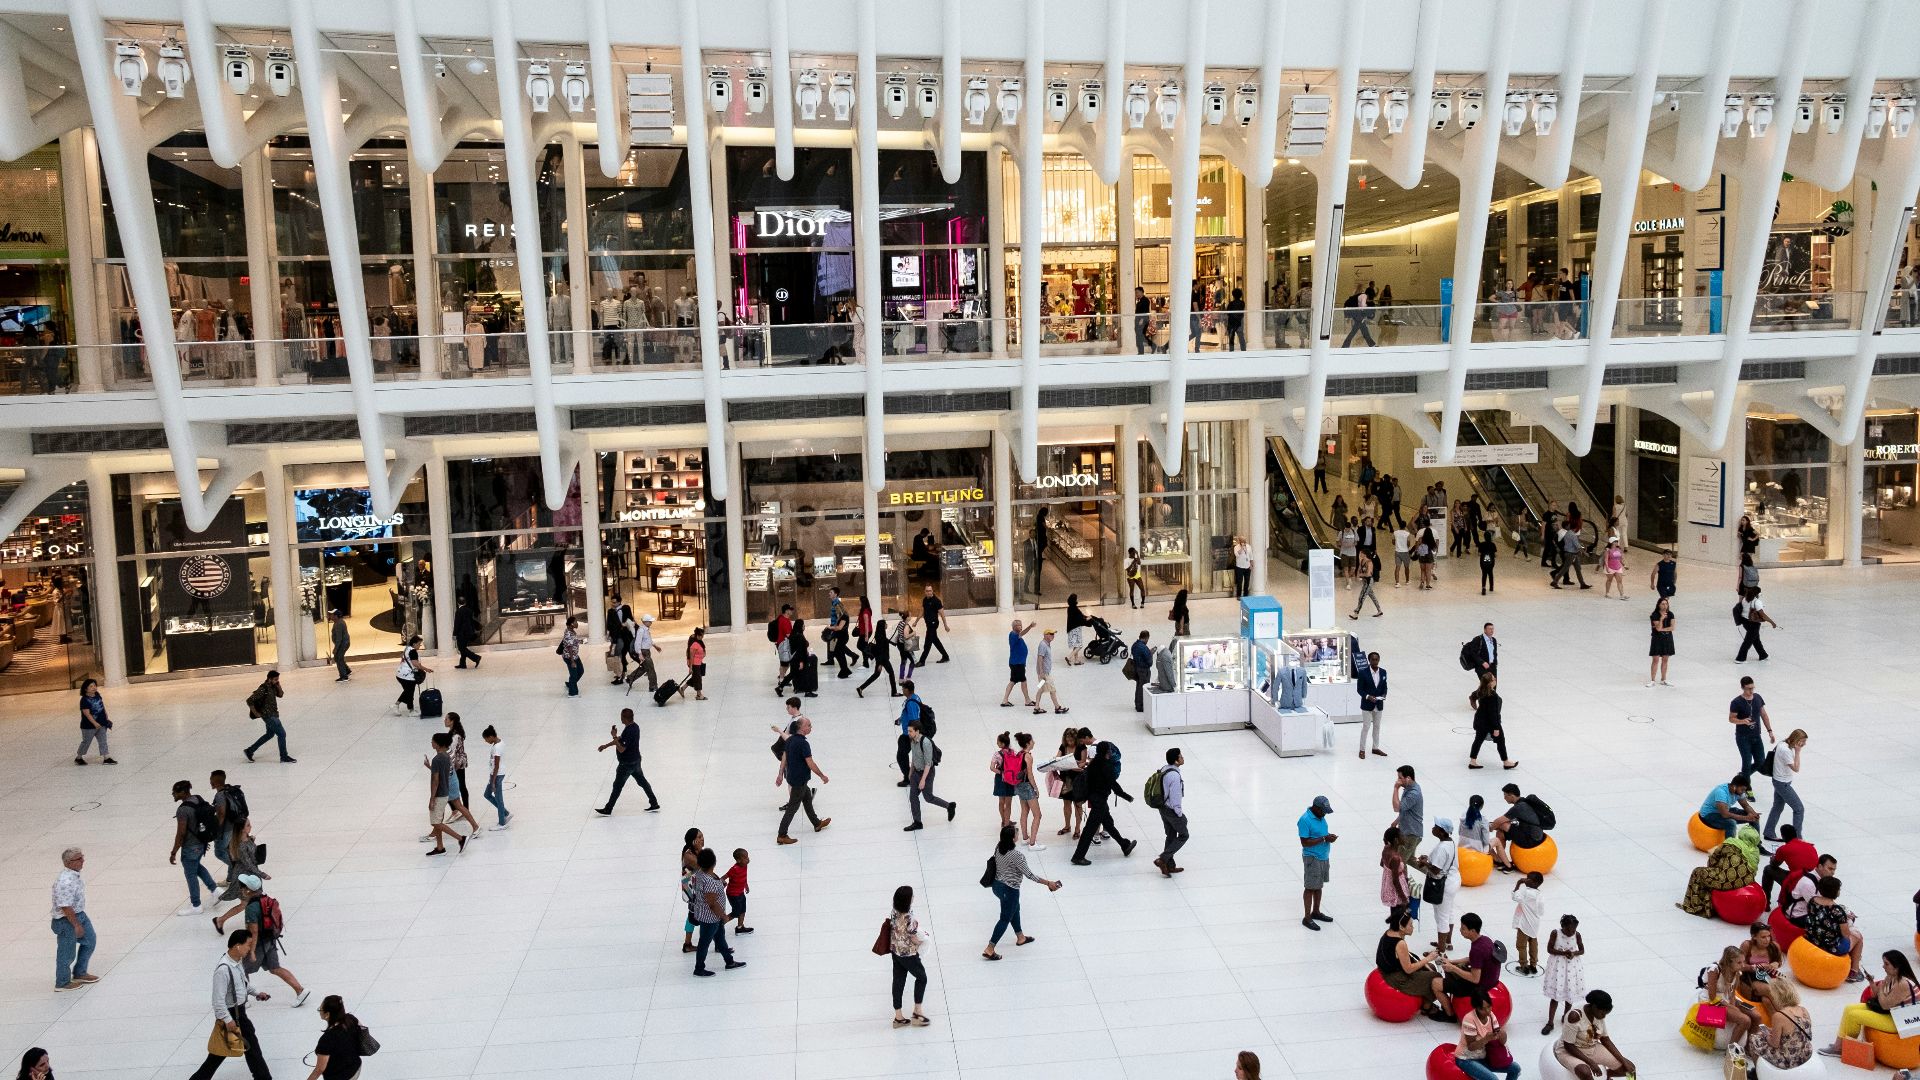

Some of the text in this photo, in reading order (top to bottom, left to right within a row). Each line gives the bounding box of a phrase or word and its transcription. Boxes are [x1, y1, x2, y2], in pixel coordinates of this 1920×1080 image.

[465, 223, 517, 237] REIS
[757, 211, 830, 237] Dior
[1634, 217, 1684, 232] COLE HAAN
[481, 260, 514, 268] REISS
[1758, 261, 1811, 293] Pinch
[1634, 440, 1660, 452] ROBERTO
[1036, 473, 1099, 489] LONDON
[890, 488, 984, 505] BREITLING
[619, 507, 697, 522] MONTBLANC
[1904, 1016, 1920, 1024] MoM
